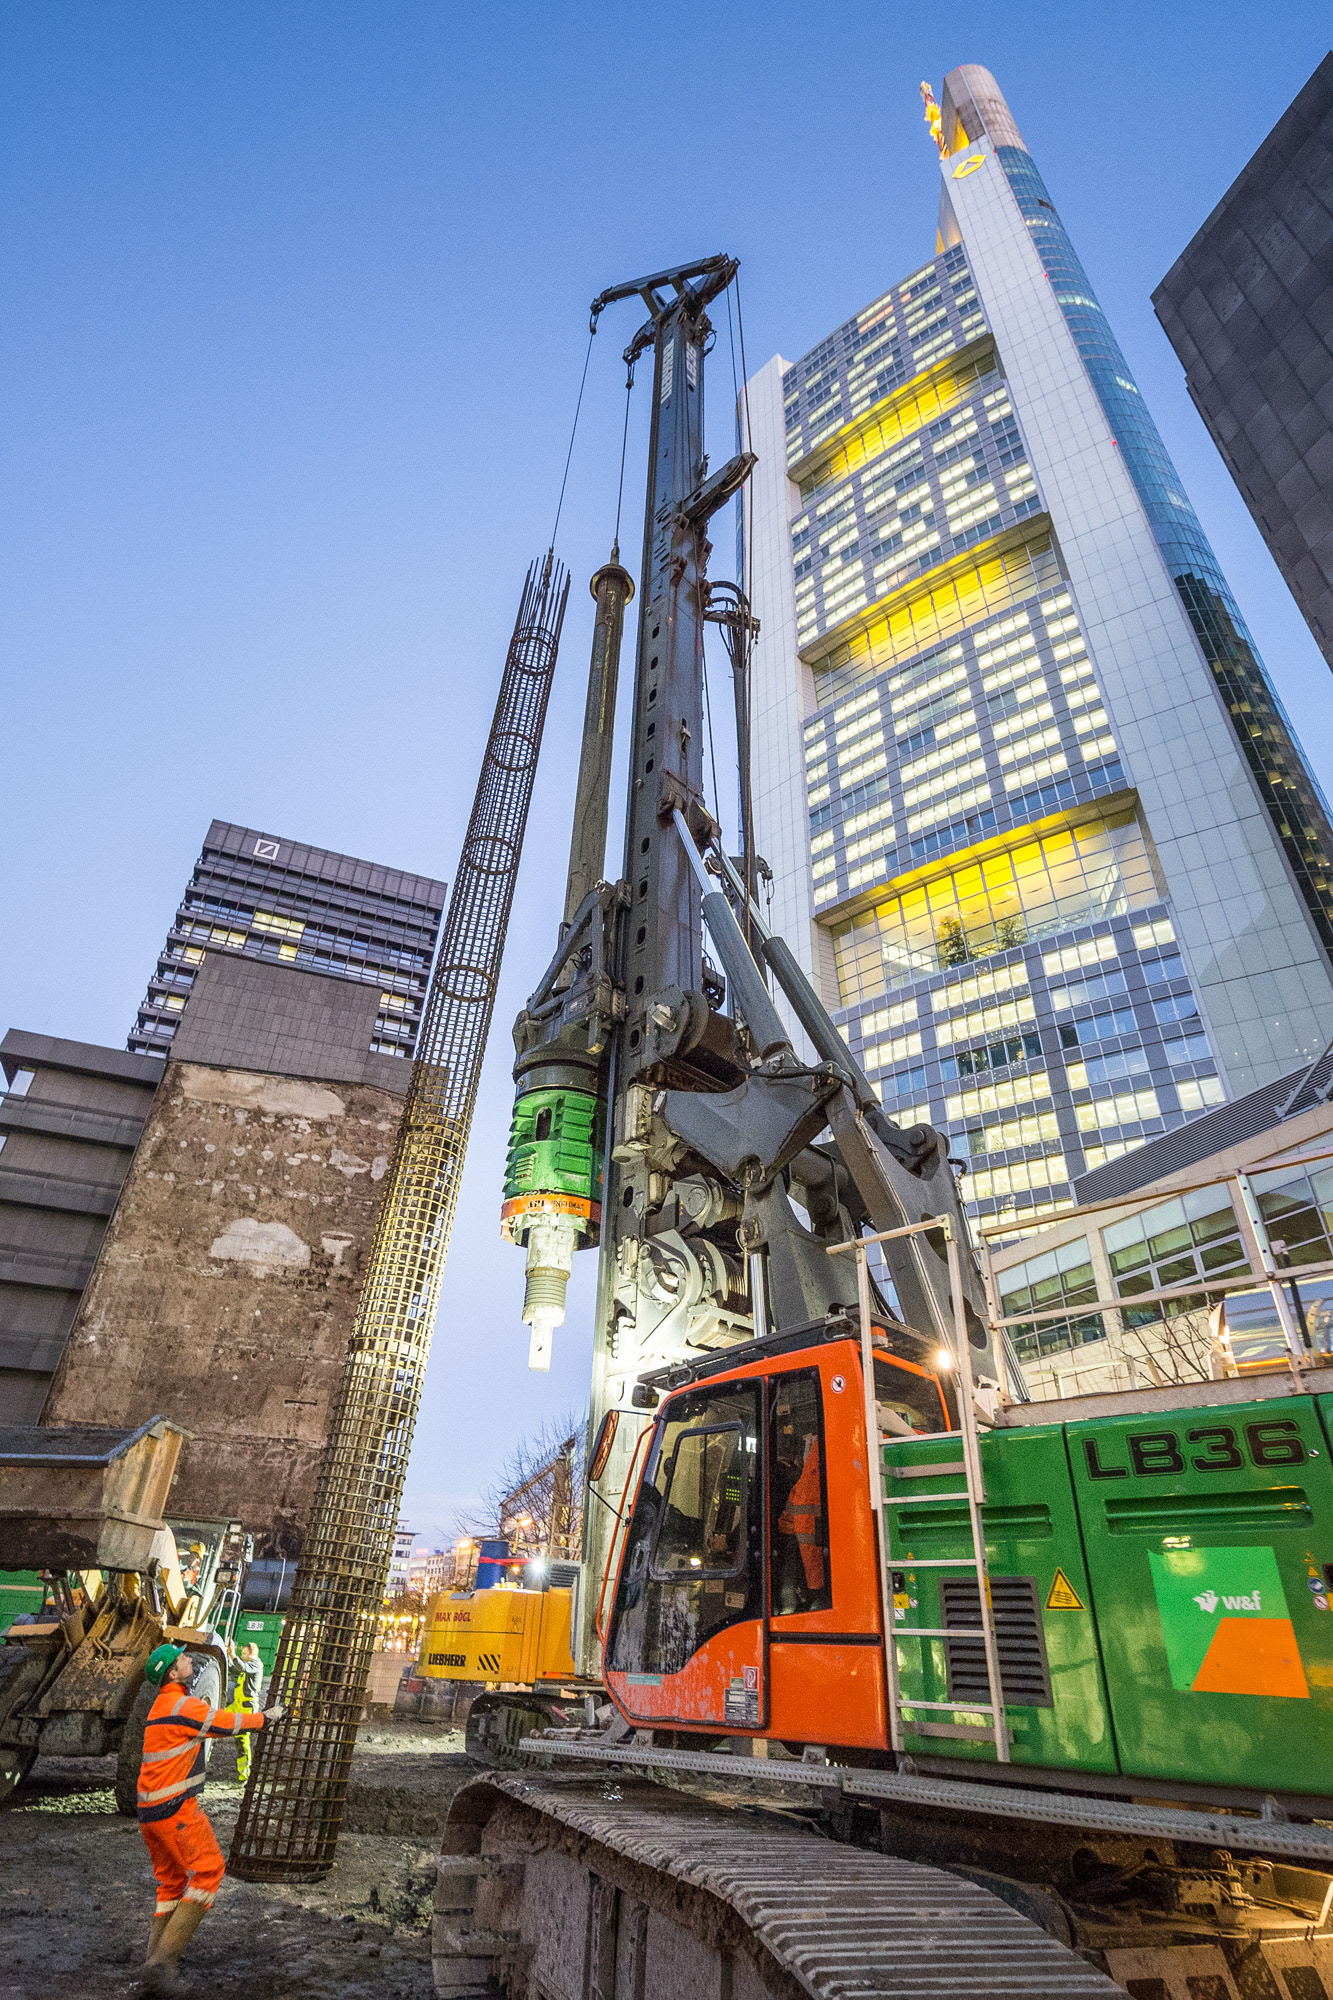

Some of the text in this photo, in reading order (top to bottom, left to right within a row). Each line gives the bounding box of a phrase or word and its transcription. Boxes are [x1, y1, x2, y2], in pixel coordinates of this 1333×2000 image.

[660, 338, 675, 404] LIEBHERR
[686, 341, 697, 388] LB36
[1082, 1418, 1308, 1482] LB36
[434, 1609, 471, 1622] MAX BÖGL
[1220, 1590, 1261, 1611] w&f
[428, 1653, 467, 1667] LIEBHERR
